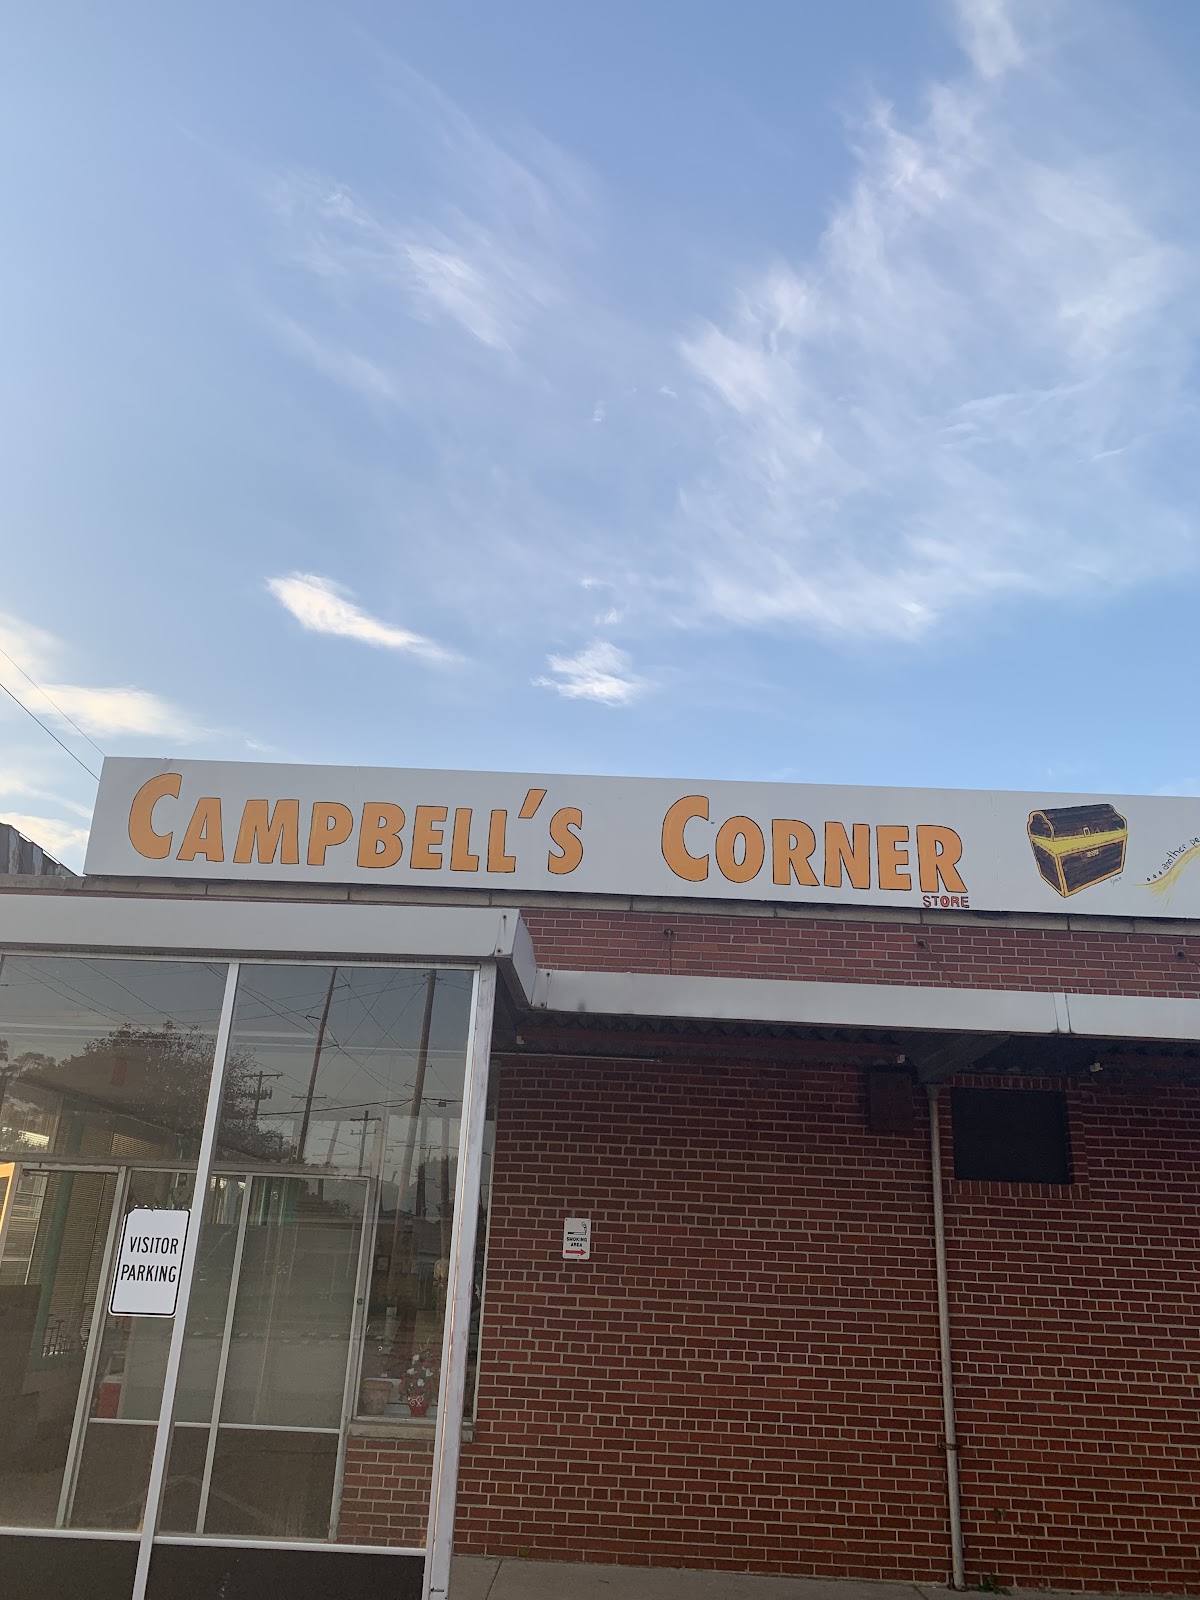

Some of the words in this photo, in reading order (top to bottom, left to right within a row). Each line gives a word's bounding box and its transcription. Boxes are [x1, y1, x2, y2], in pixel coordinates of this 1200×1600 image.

[128, 773, 584, 875] CAMPBELL'S
[661, 795, 968, 894] CORNER
[1189, 837, 1200, 849] pe
[922, 895, 970, 909] STORE
[130, 1236, 179, 1254] VISITOR
[120, 1264, 177, 1283] PARKING
